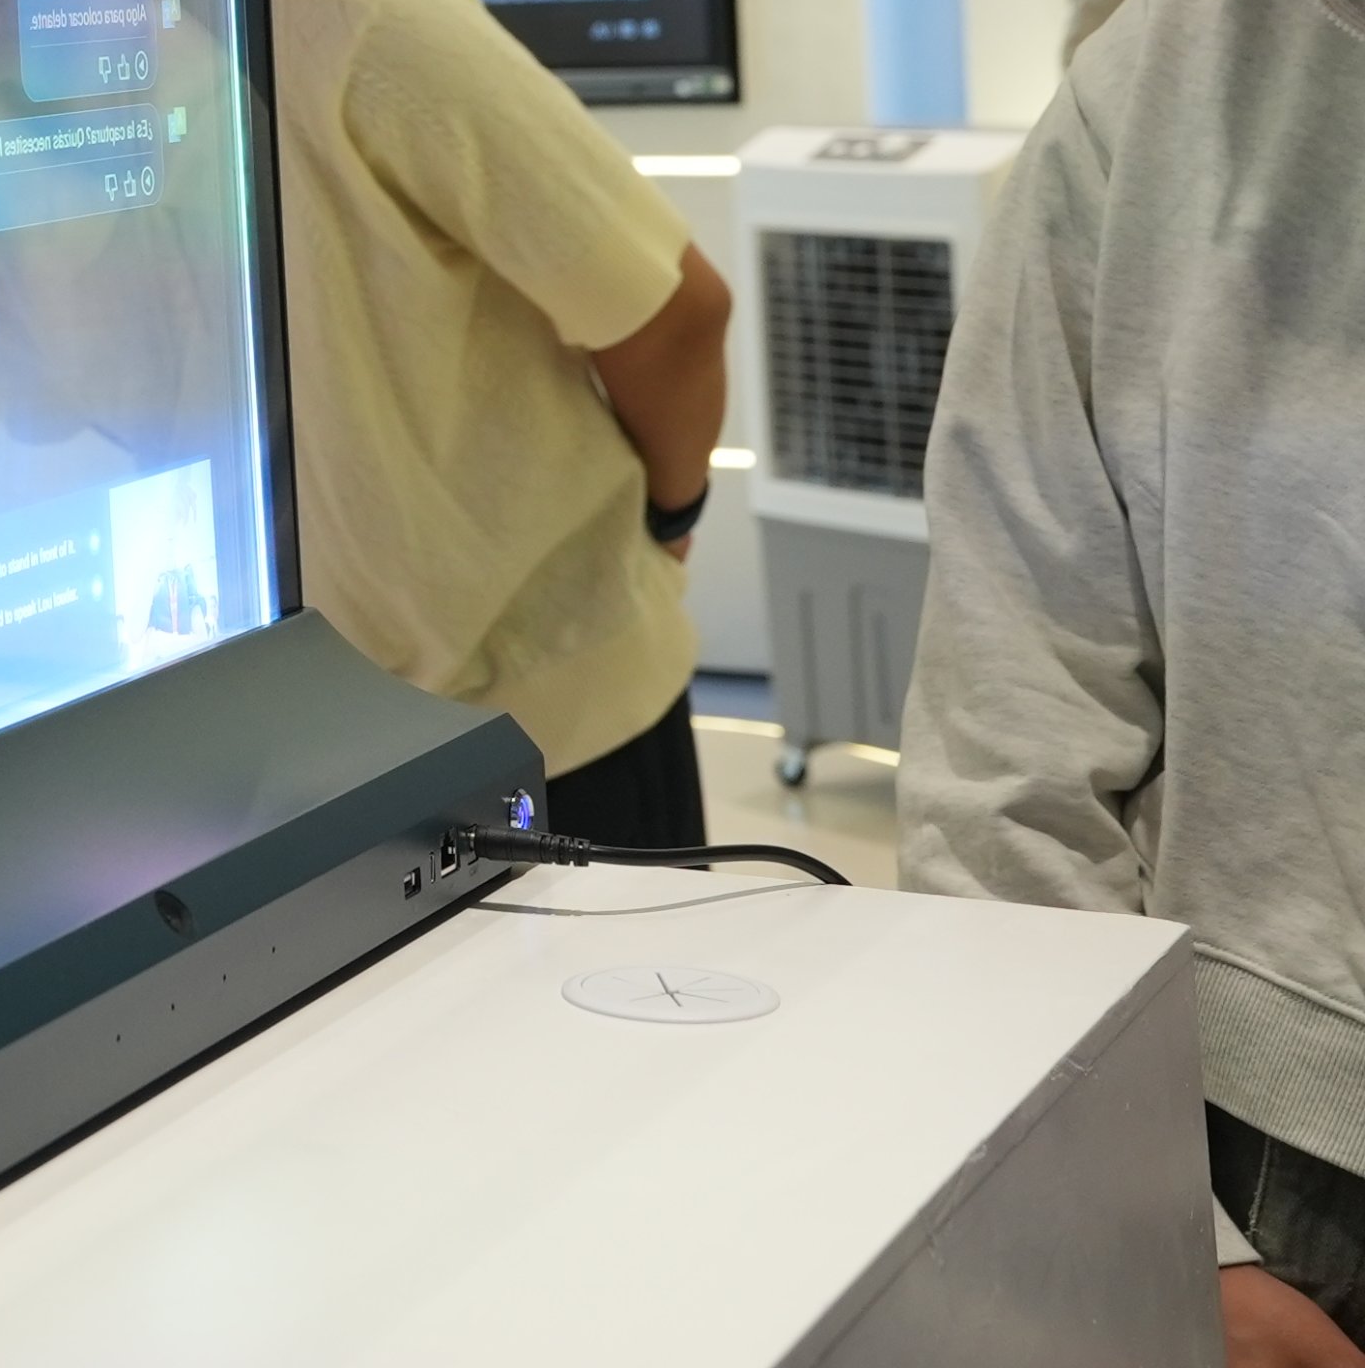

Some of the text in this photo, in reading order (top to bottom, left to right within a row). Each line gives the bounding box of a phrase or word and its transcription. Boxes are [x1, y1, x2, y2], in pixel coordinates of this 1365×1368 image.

[8, 552, 30, 575] stand
[30, 552, 39, 564] in
[39, 546, 58, 563] front
[58, 540, 66, 557] of
[4, 610, 13, 625] to
[14, 599, 37, 624] speak
